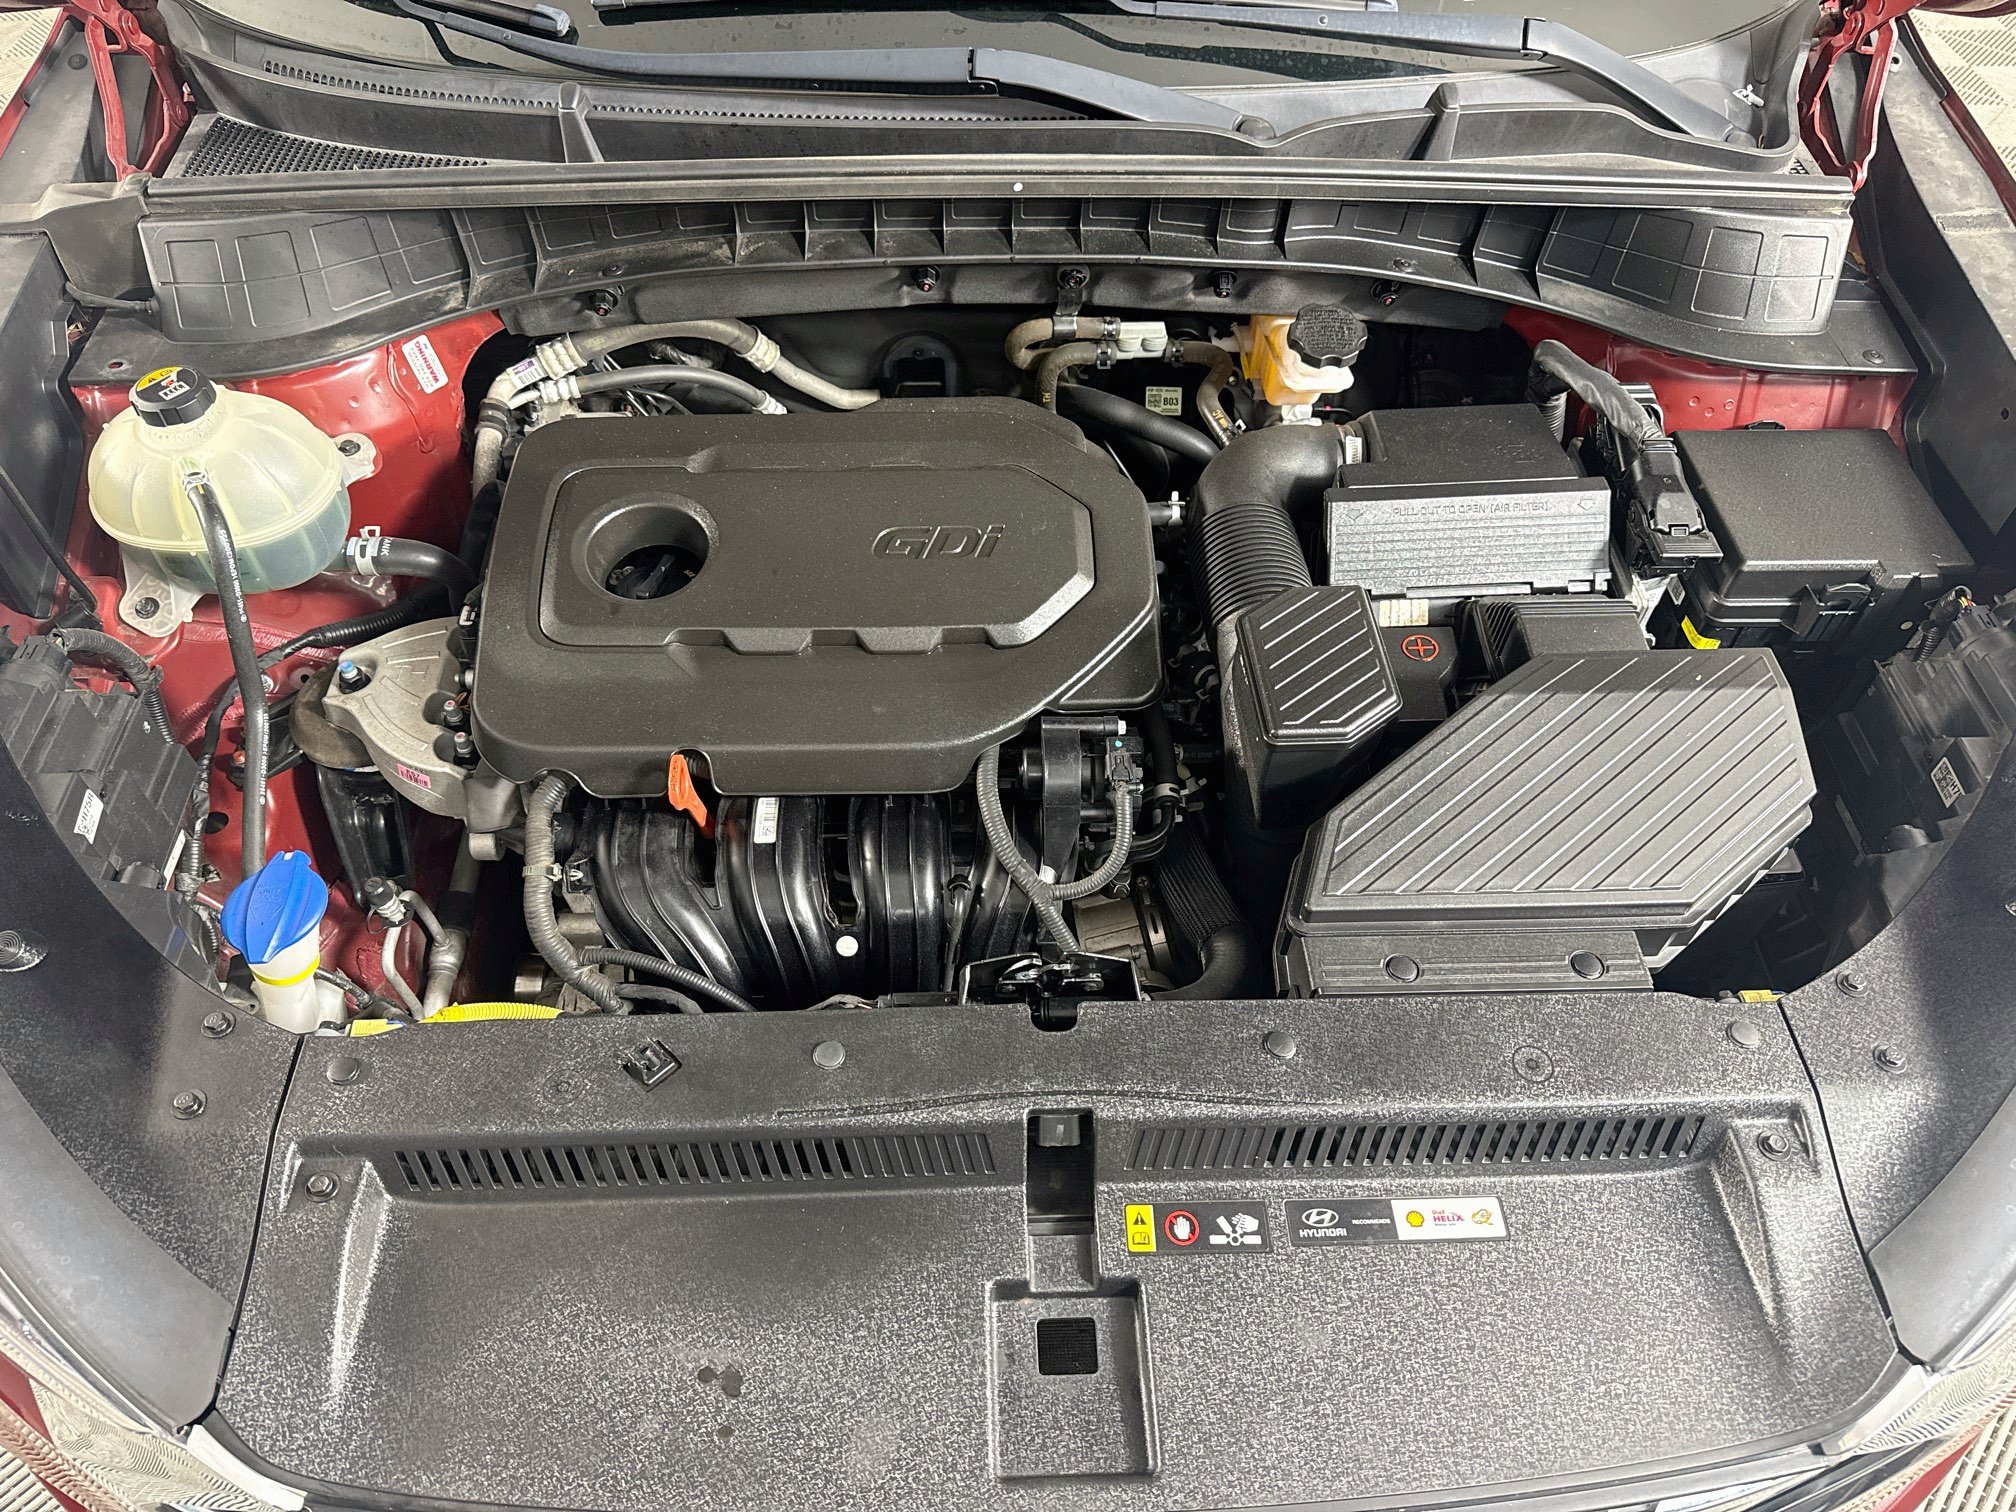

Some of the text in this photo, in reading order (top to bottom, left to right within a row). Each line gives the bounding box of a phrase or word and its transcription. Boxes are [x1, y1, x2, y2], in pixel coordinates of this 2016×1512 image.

[414, 341, 439, 383] WARNING
[1163, 397, 1179, 406] B03
[1393, 507, 1419, 517] PULL
[1420, 505, 1441, 515] OUT
[1443, 505, 1456, 514] TO
[1458, 503, 1486, 514] OPEN
[1433, 1214, 1464, 1222] HELIX
[1299, 1227, 1348, 1238] HYUNDAI
